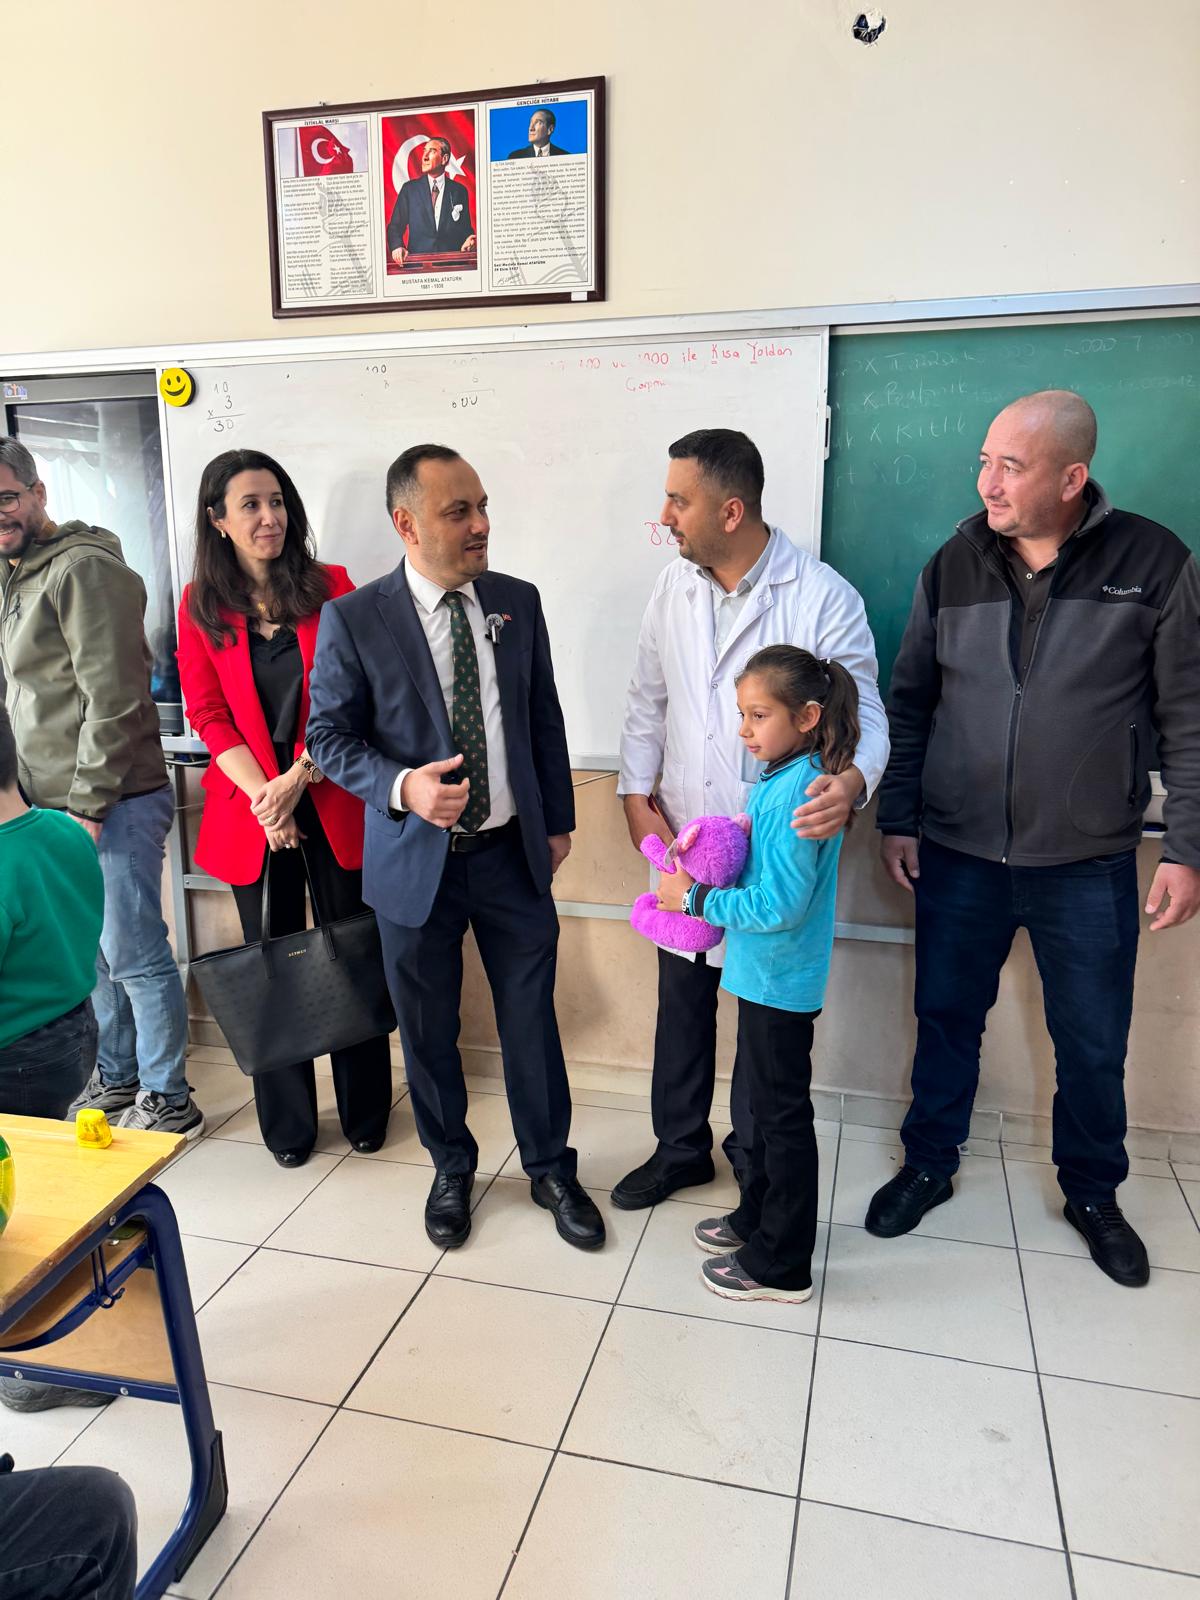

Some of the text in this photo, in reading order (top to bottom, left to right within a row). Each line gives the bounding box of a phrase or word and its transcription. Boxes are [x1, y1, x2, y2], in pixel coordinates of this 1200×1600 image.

[747, 341, 792, 361] Yoldan
[214, 381, 229, 394] 10
[224, 394, 233, 410] 3
[214, 418, 234, 433] 30
[1108, 585, 1142, 596] Columbia
